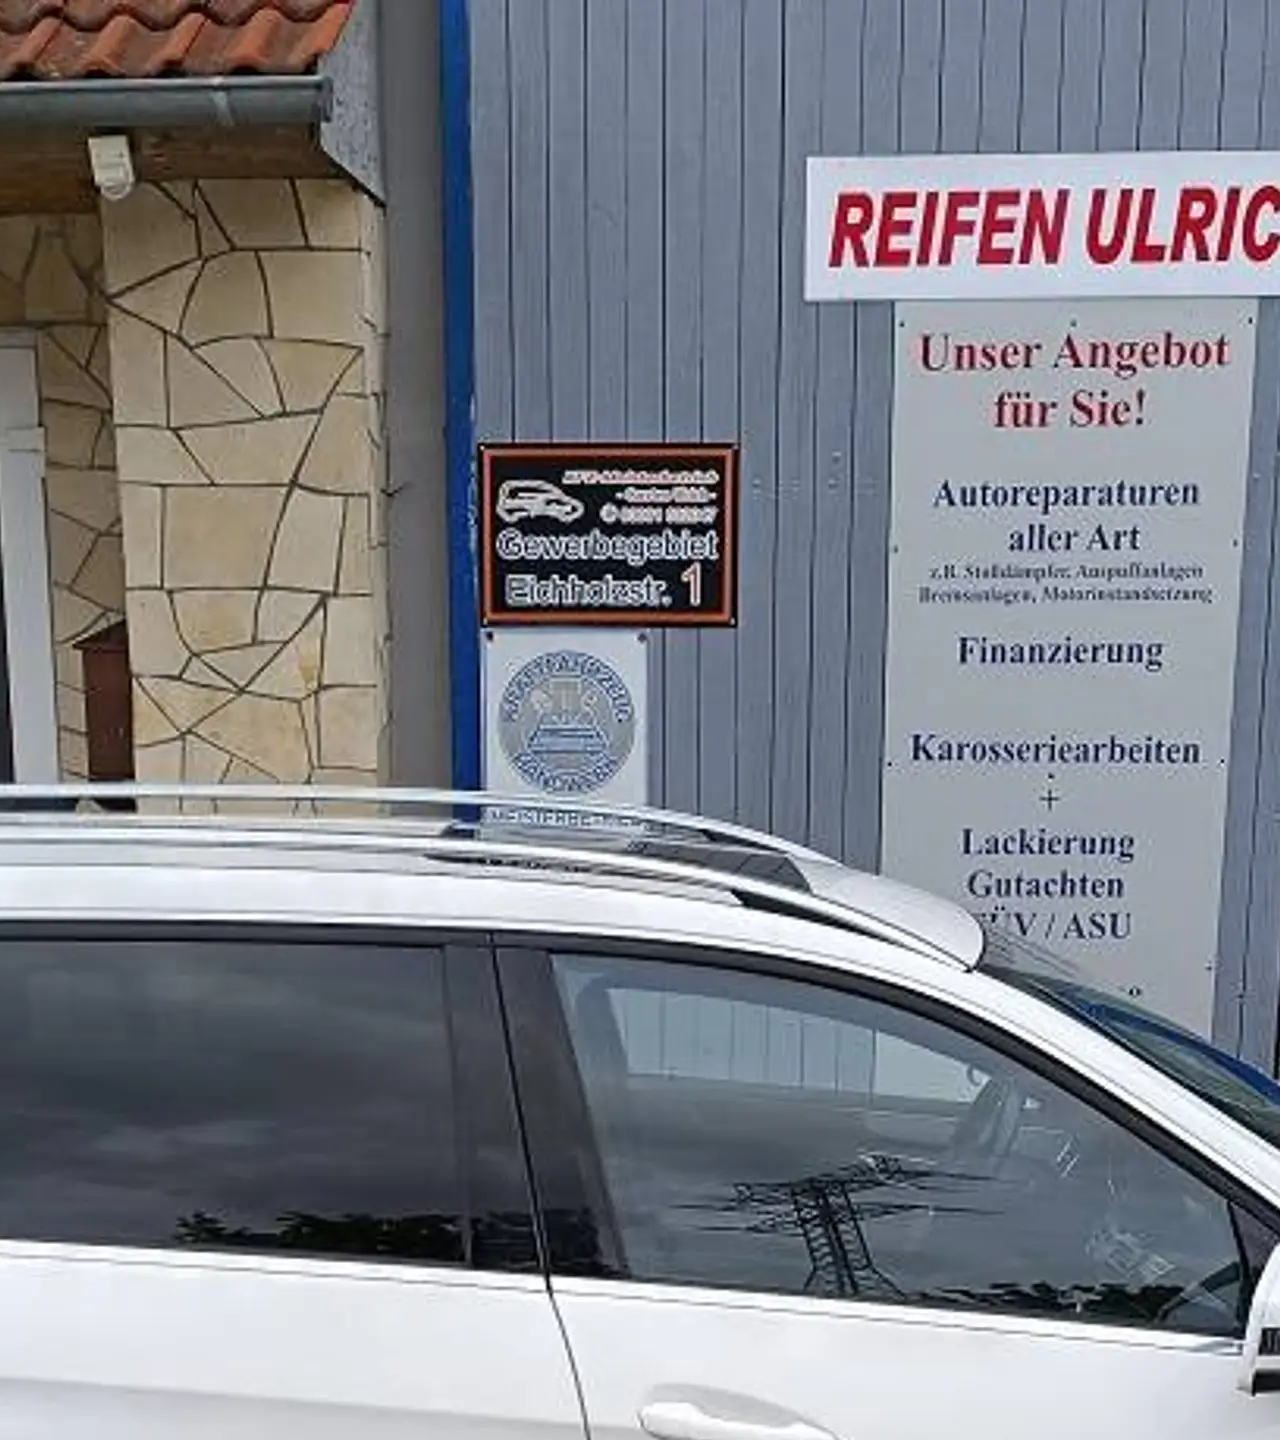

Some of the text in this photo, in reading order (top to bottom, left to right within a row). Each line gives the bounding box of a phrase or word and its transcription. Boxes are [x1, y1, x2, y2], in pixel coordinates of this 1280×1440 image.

[827, 187, 1071, 268] REIFEN
[919, 331, 1231, 377] Unser Angebot
[993, 388, 1147, 429] für Sie!
[932, 478, 1200, 515] Autoreparaturen
[497, 527, 720, 566] Gewerbegebiet
[1008, 523, 1141, 551] aller Art
[505, 561, 702, 607] Eichholzstr. 1
[958, 636, 1165, 671] Finanzierung
[912, 733, 1201, 765] Karosseriearbeiten
[962, 827, 1136, 862] Lackierung
[966, 868, 1125, 899] Gutachten
[1063, 912, 1132, 939] ASU
